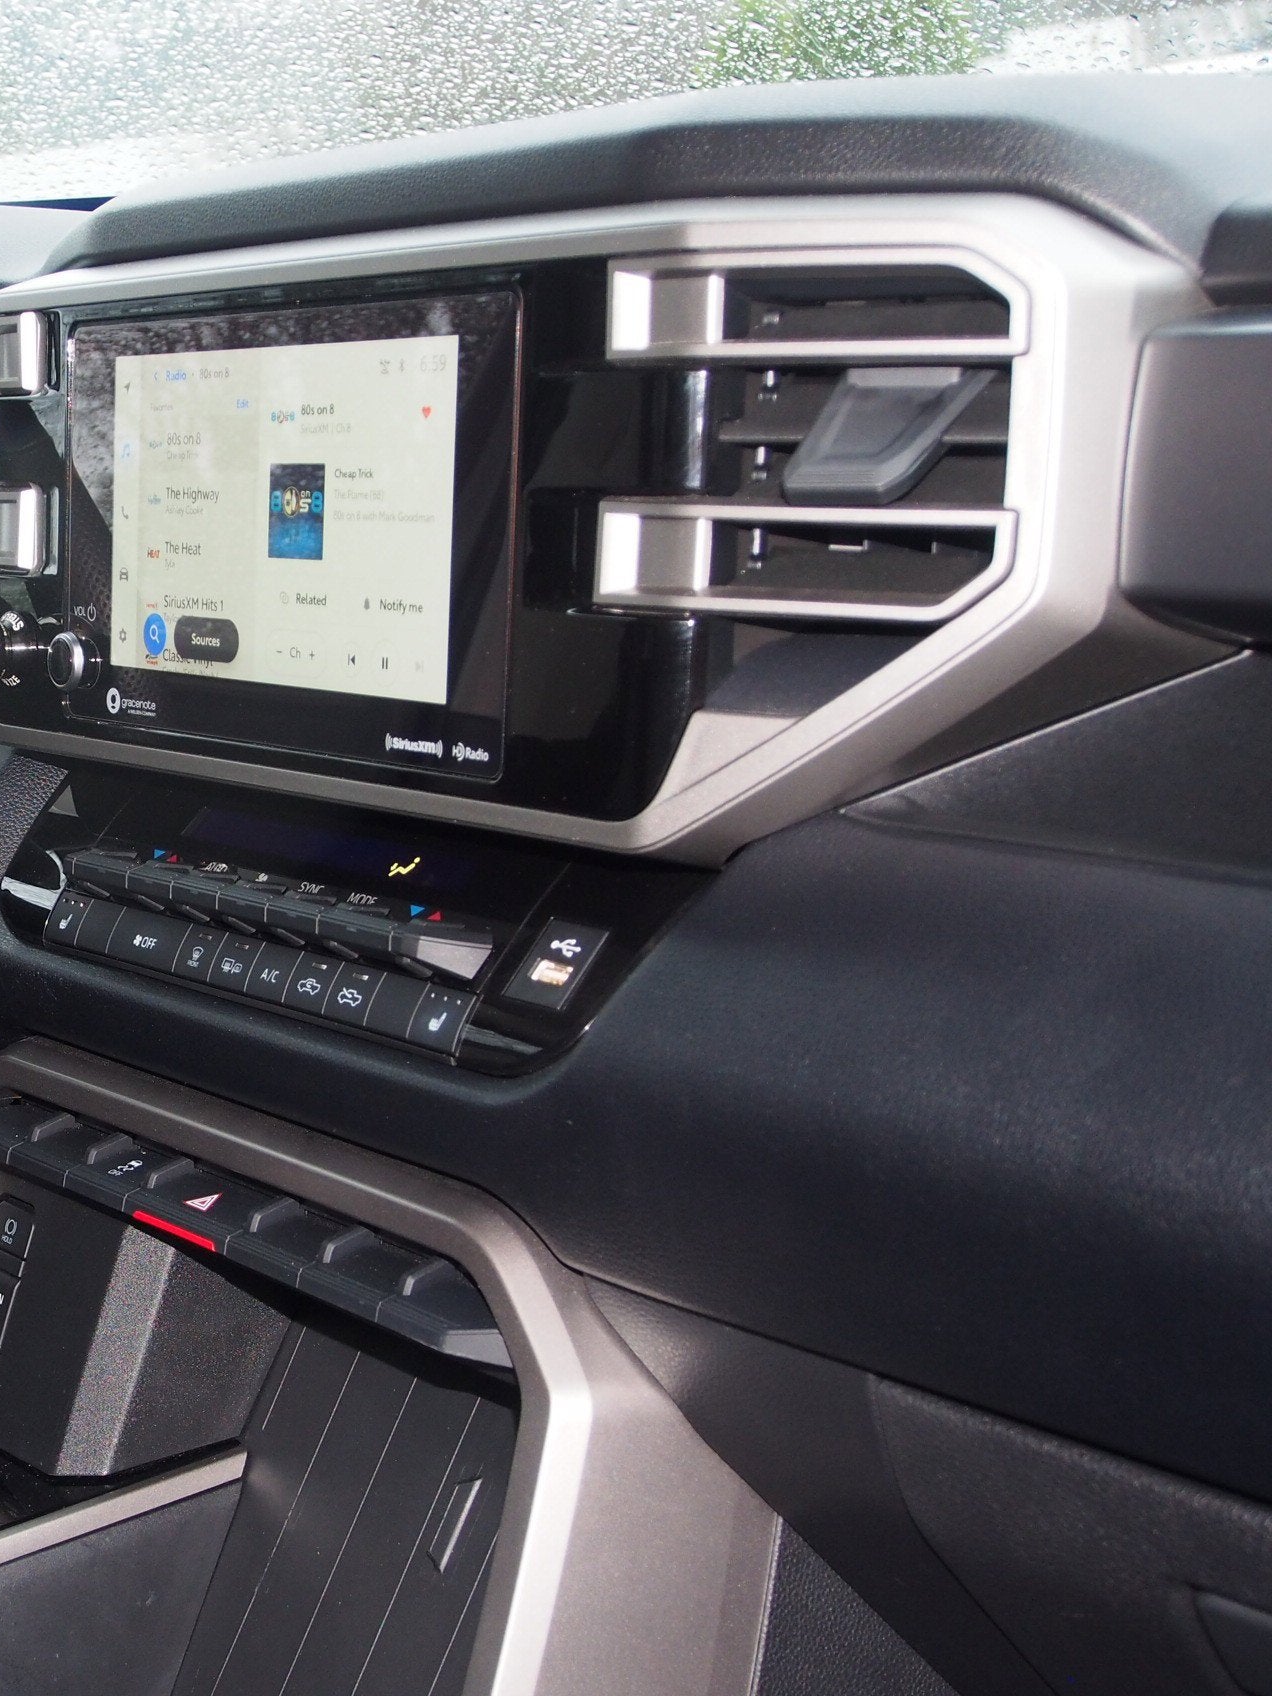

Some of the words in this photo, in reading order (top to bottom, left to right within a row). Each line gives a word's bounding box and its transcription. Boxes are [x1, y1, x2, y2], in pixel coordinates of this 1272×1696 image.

[420, 354, 447, 372] 6:59
[166, 369, 187, 381] Radio
[199, 368, 212, 379] 80s
[214, 369, 224, 379] on
[236, 399, 249, 409] Edit
[300, 404, 315, 415] 80s
[317, 405, 328, 415] on
[329, 403, 335, 415] 8
[166, 432, 182, 446] 80s
[183, 434, 194, 445] on
[195, 431, 202, 445] 8
[334, 468, 356, 480] Cheap
[358, 468, 374, 479] Trick
[166, 487, 181, 500] The
[182, 487, 220, 503] Highway
[165, 541, 180, 554] The
[181, 541, 202, 556] Heat
[163, 595, 199, 610] SiriusXM
[201, 597, 218, 612] Hits
[295, 592, 327, 606] Related
[73, 605, 87, 617] VOL
[379, 598, 407, 615] Notify
[409, 602, 424, 613] me
[190, 633, 221, 647] Sources
[289, 646, 301, 659] Ch
[121, 698, 156, 711] gracenote
[465, 747, 490, 762] Radio
[141, 936, 158, 950] OFF
[260, 968, 280, 983] A/C
[0, 1235, 13, 1245] HOLD
